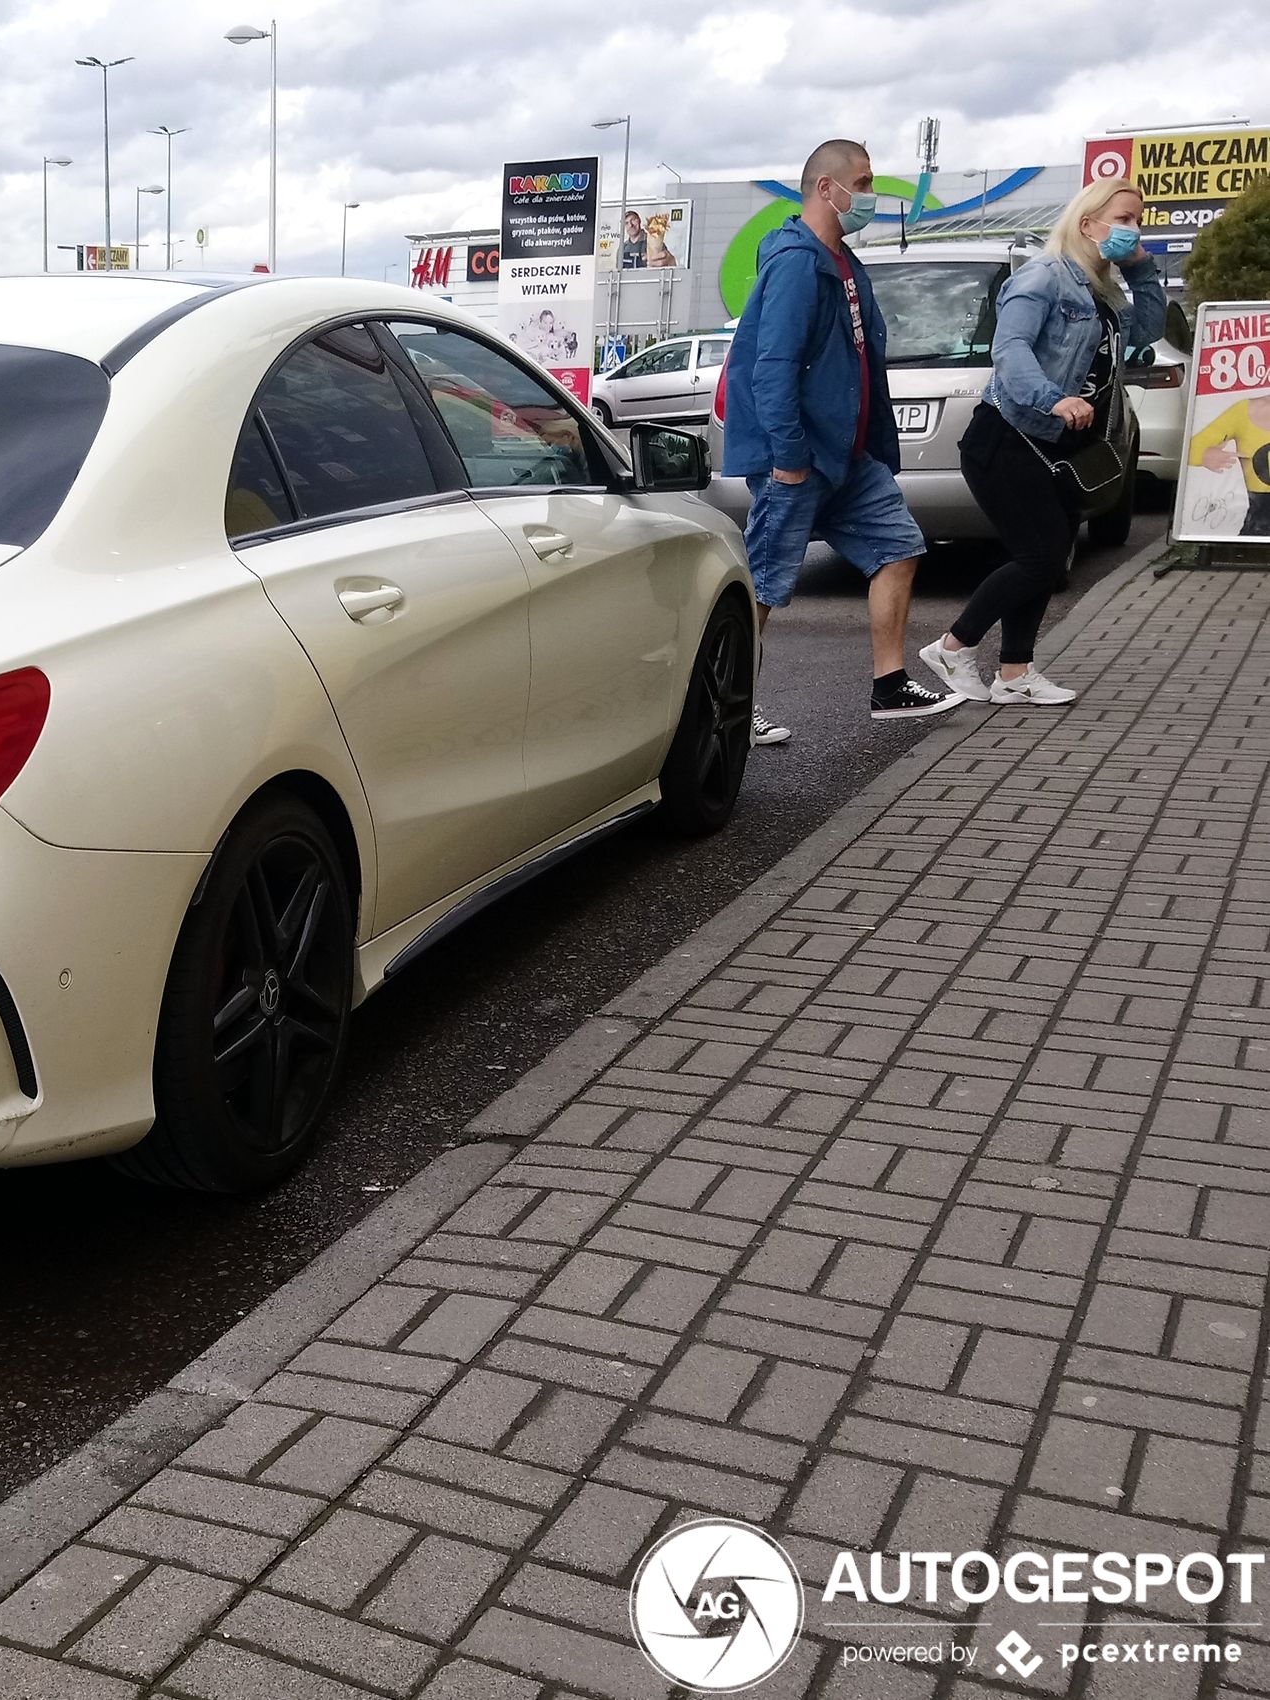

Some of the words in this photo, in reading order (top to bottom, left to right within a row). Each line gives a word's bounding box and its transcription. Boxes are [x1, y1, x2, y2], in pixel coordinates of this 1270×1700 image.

[509, 173, 590, 195] KAKADU
[1137, 171, 1209, 196] NISKIE
[532, 195, 543, 203] dla
[510, 216, 536, 225] wszystko
[537, 215, 548, 223] dla
[548, 214, 565, 224] psów,
[566, 213, 587, 222] kotów,
[512, 229, 536, 238] gryzoni,
[537, 228, 562, 236] ptaków,
[563, 225, 584, 234] gadów
[524, 238, 534, 246] dla
[535, 237, 573, 246] akwarystyki
[412, 246, 453, 289] H&M
[511, 265, 582, 278] SERDECZNIE
[521, 283, 568, 295] WITAMY
